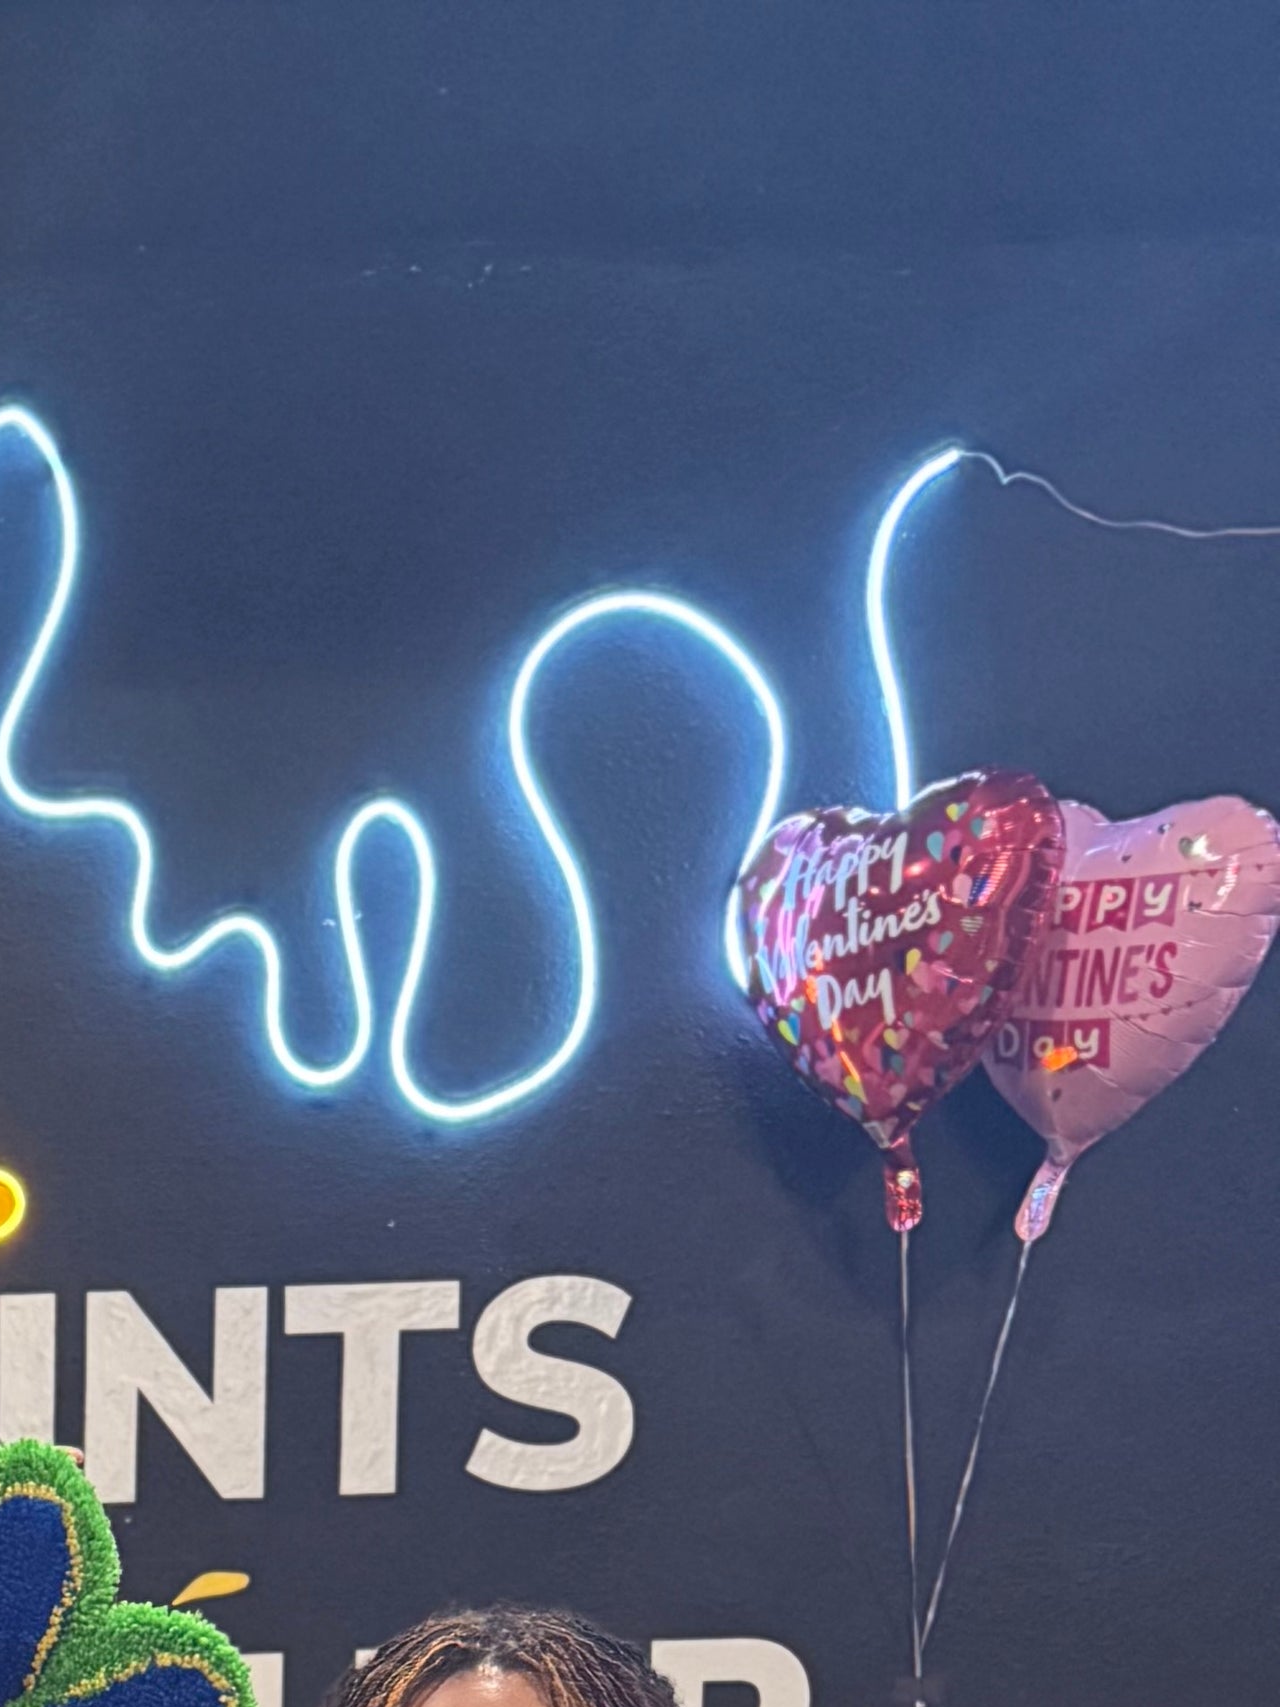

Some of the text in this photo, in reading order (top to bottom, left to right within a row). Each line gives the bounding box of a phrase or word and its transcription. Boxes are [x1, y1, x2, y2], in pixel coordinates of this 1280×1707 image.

[782, 831, 908, 913] Happy
[1053, 882, 1174, 926] ppy
[816, 968, 896, 1030] Day
[1023, 941, 1178, 1009] NTINE'S
